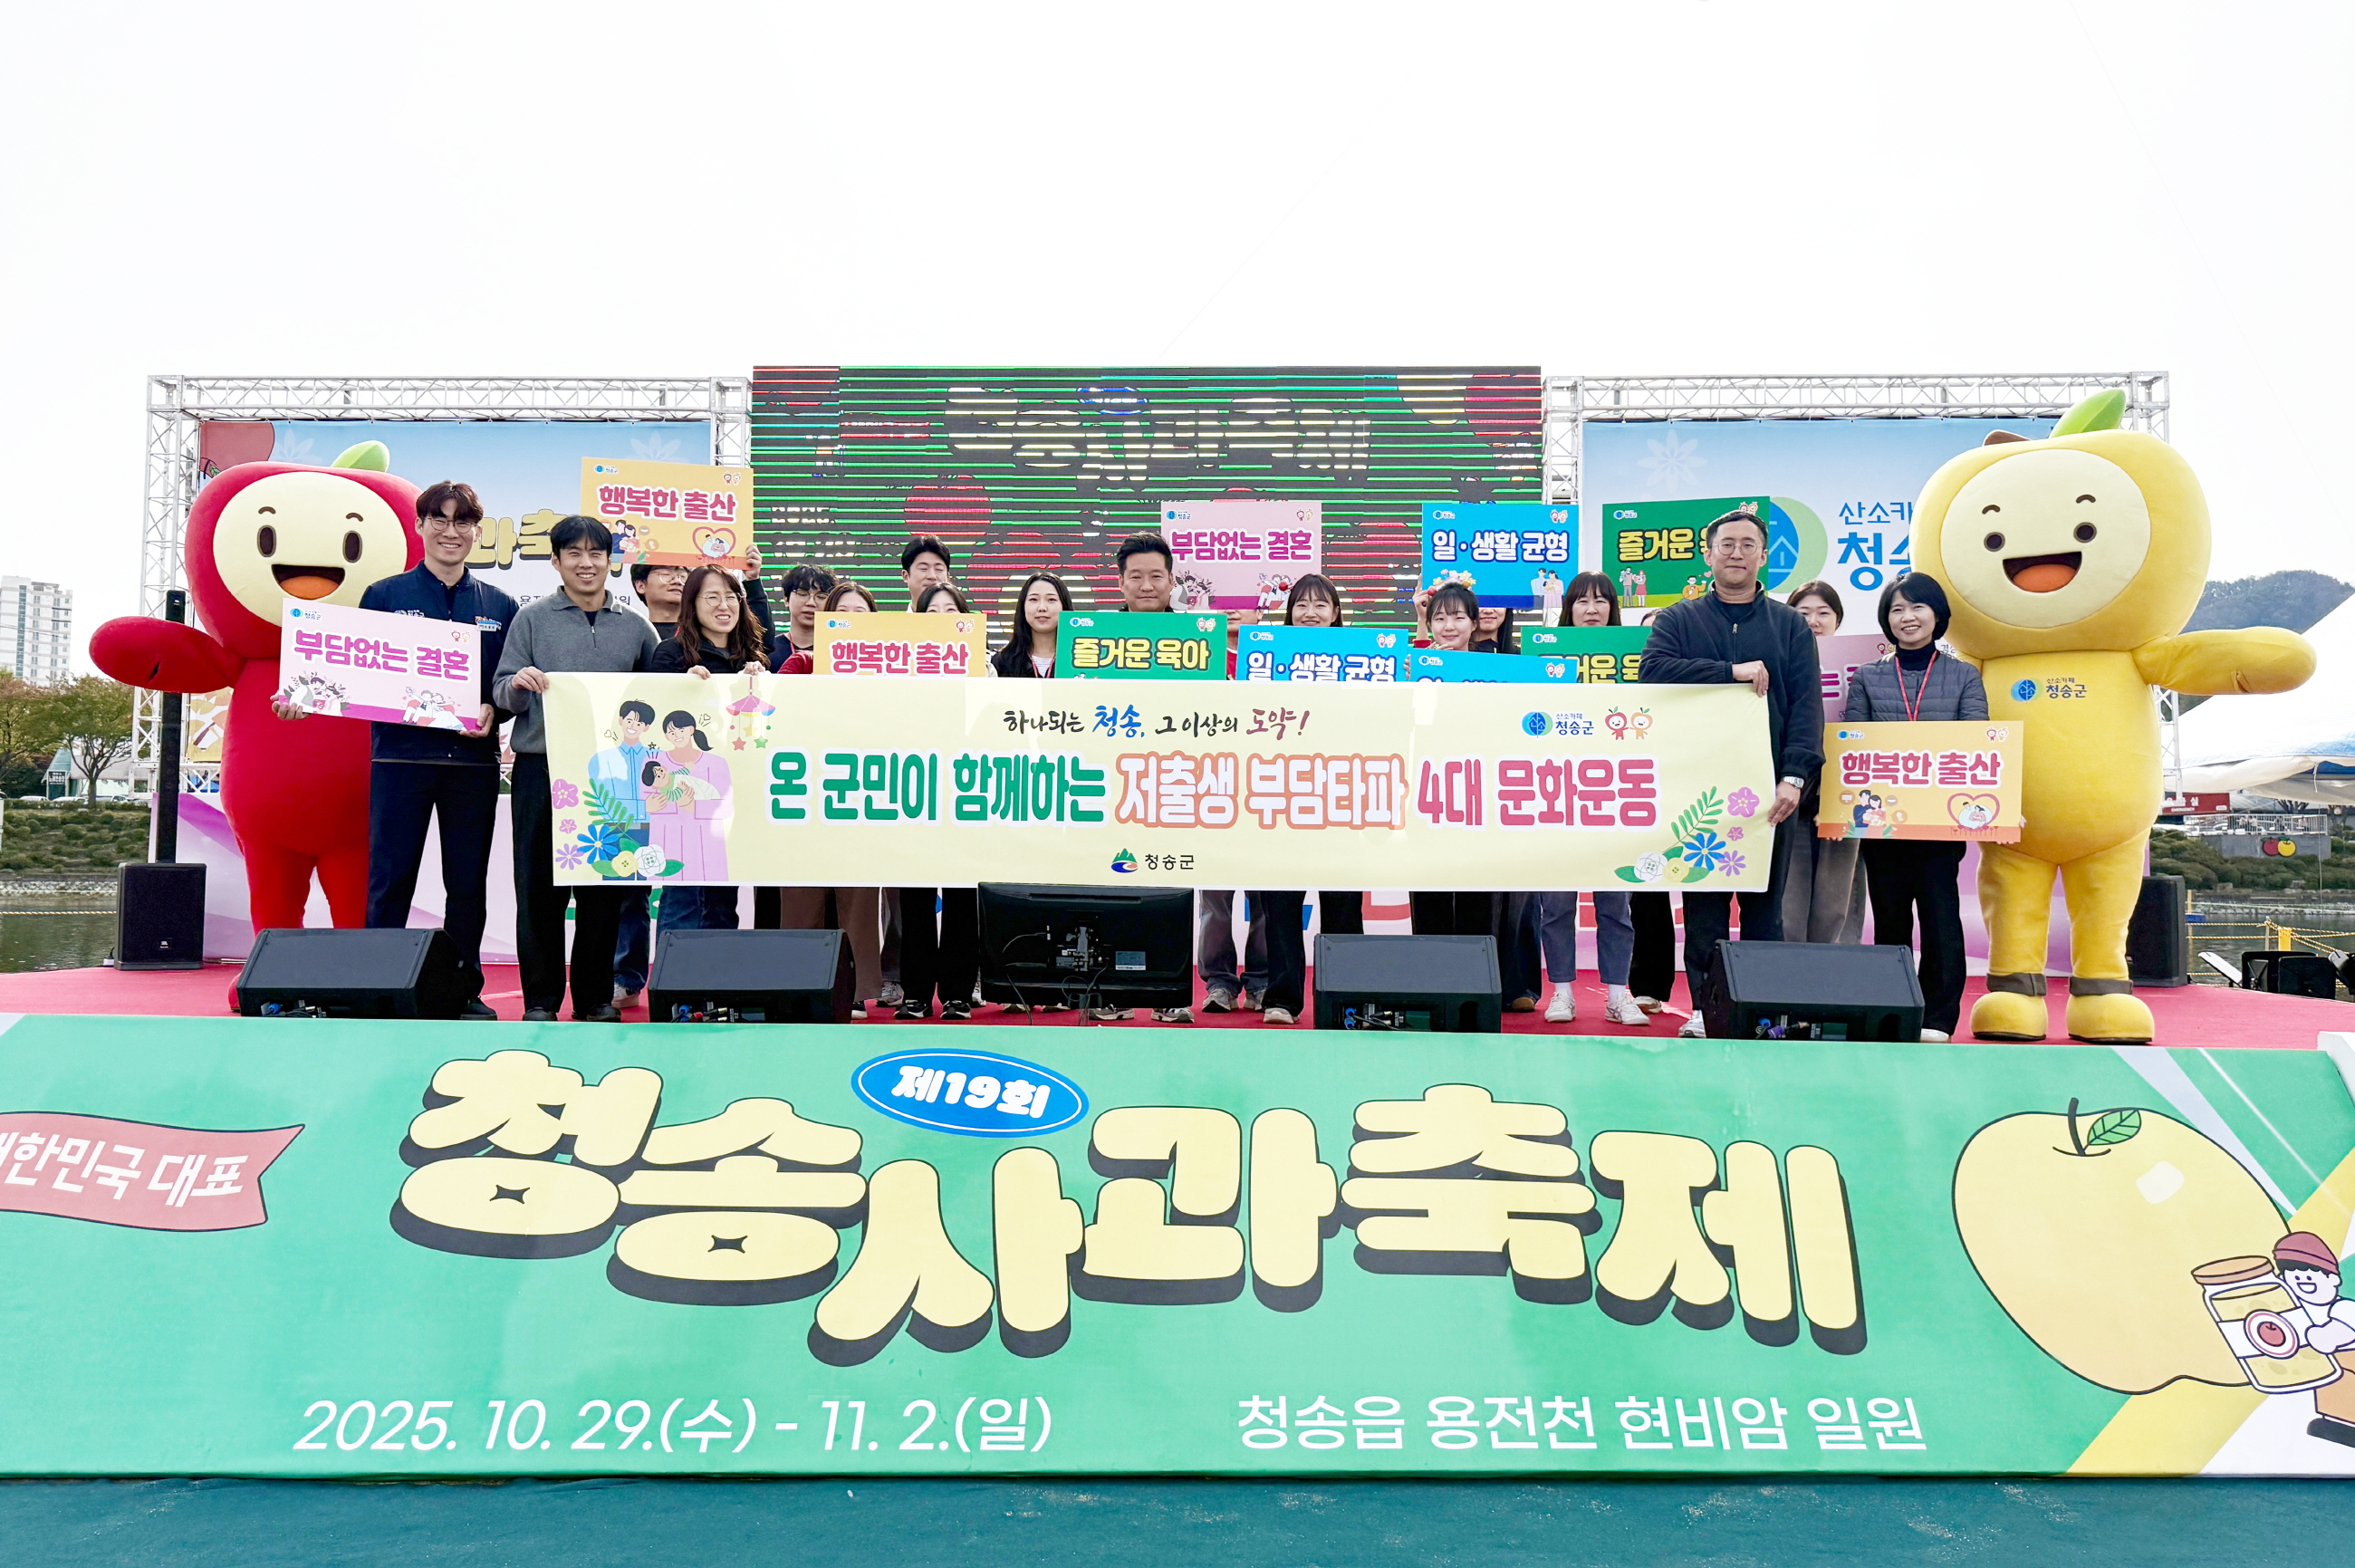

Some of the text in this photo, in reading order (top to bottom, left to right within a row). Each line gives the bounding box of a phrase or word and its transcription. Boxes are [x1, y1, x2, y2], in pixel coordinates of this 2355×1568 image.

[599, 486, 678, 519] 행복한
[684, 491, 735, 522] 출산
[1171, 530, 1312, 561] 부담없는 결혼
[1522, 531, 1569, 561] 균형
[1619, 529, 1694, 561] 즐거운
[294, 630, 469, 681] 부담없는 결혼
[831, 641, 967, 675] 행복한 출산
[1072, 638, 1209, 670] 즐거운 육아
[1345, 655, 1395, 682] 균형
[2046, 685, 2087, 698] 청송군
[1004, 711, 1084, 735] 하나되는
[1092, 704, 1145, 737] 청송,
[1246, 707, 1310, 740] 도약!
[1555, 721, 1595, 736] 청송군
[1841, 752, 2001, 785] 행복한 출산
[770, 753, 1657, 831] 온 군민이 함께하는 저출생 부담타파 4대 문화운동
[1144, 854, 1195, 871] 청송군
[891, 1065, 1051, 1119] 제19회
[147, 1154, 249, 1207] 대표
[389, 1049, 1868, 1367] 청송사과축제
[293, 1400, 457, 1450] 2025.
[485, 1400, 550, 1450] 10.
[821, 1400, 879, 1451] 11.
[1237, 1394, 1927, 1452] 청송읍 용전천 현비암 일원
